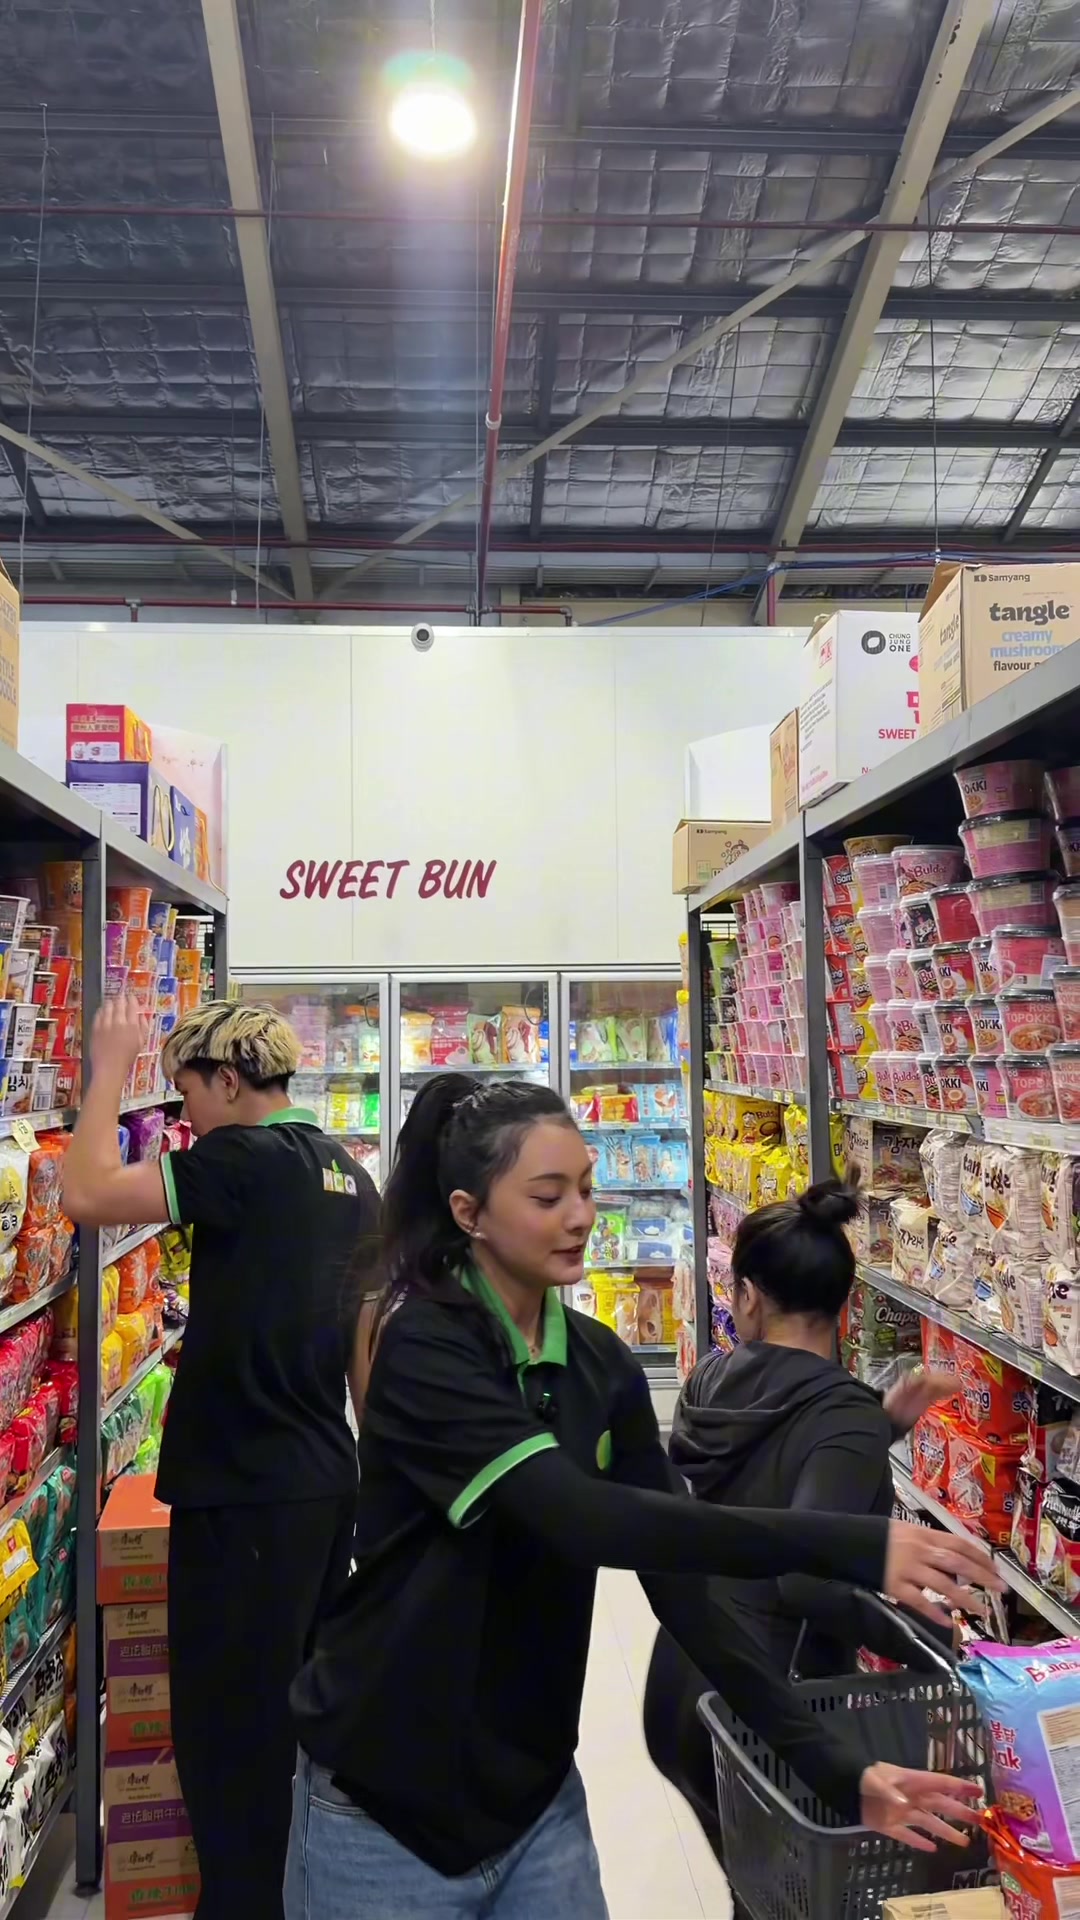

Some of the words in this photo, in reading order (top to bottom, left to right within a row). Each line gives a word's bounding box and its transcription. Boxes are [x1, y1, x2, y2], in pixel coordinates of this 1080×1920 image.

[988, 574, 1031, 583] Samyang
[989, 599, 1070, 626] tangle
[1001, 630, 1053, 643] creamy
[993, 660, 1031, 671] flavour
[878, 729, 916, 739] SWEET
[280, 859, 410, 899] SWEET
[418, 859, 497, 899] BUN
